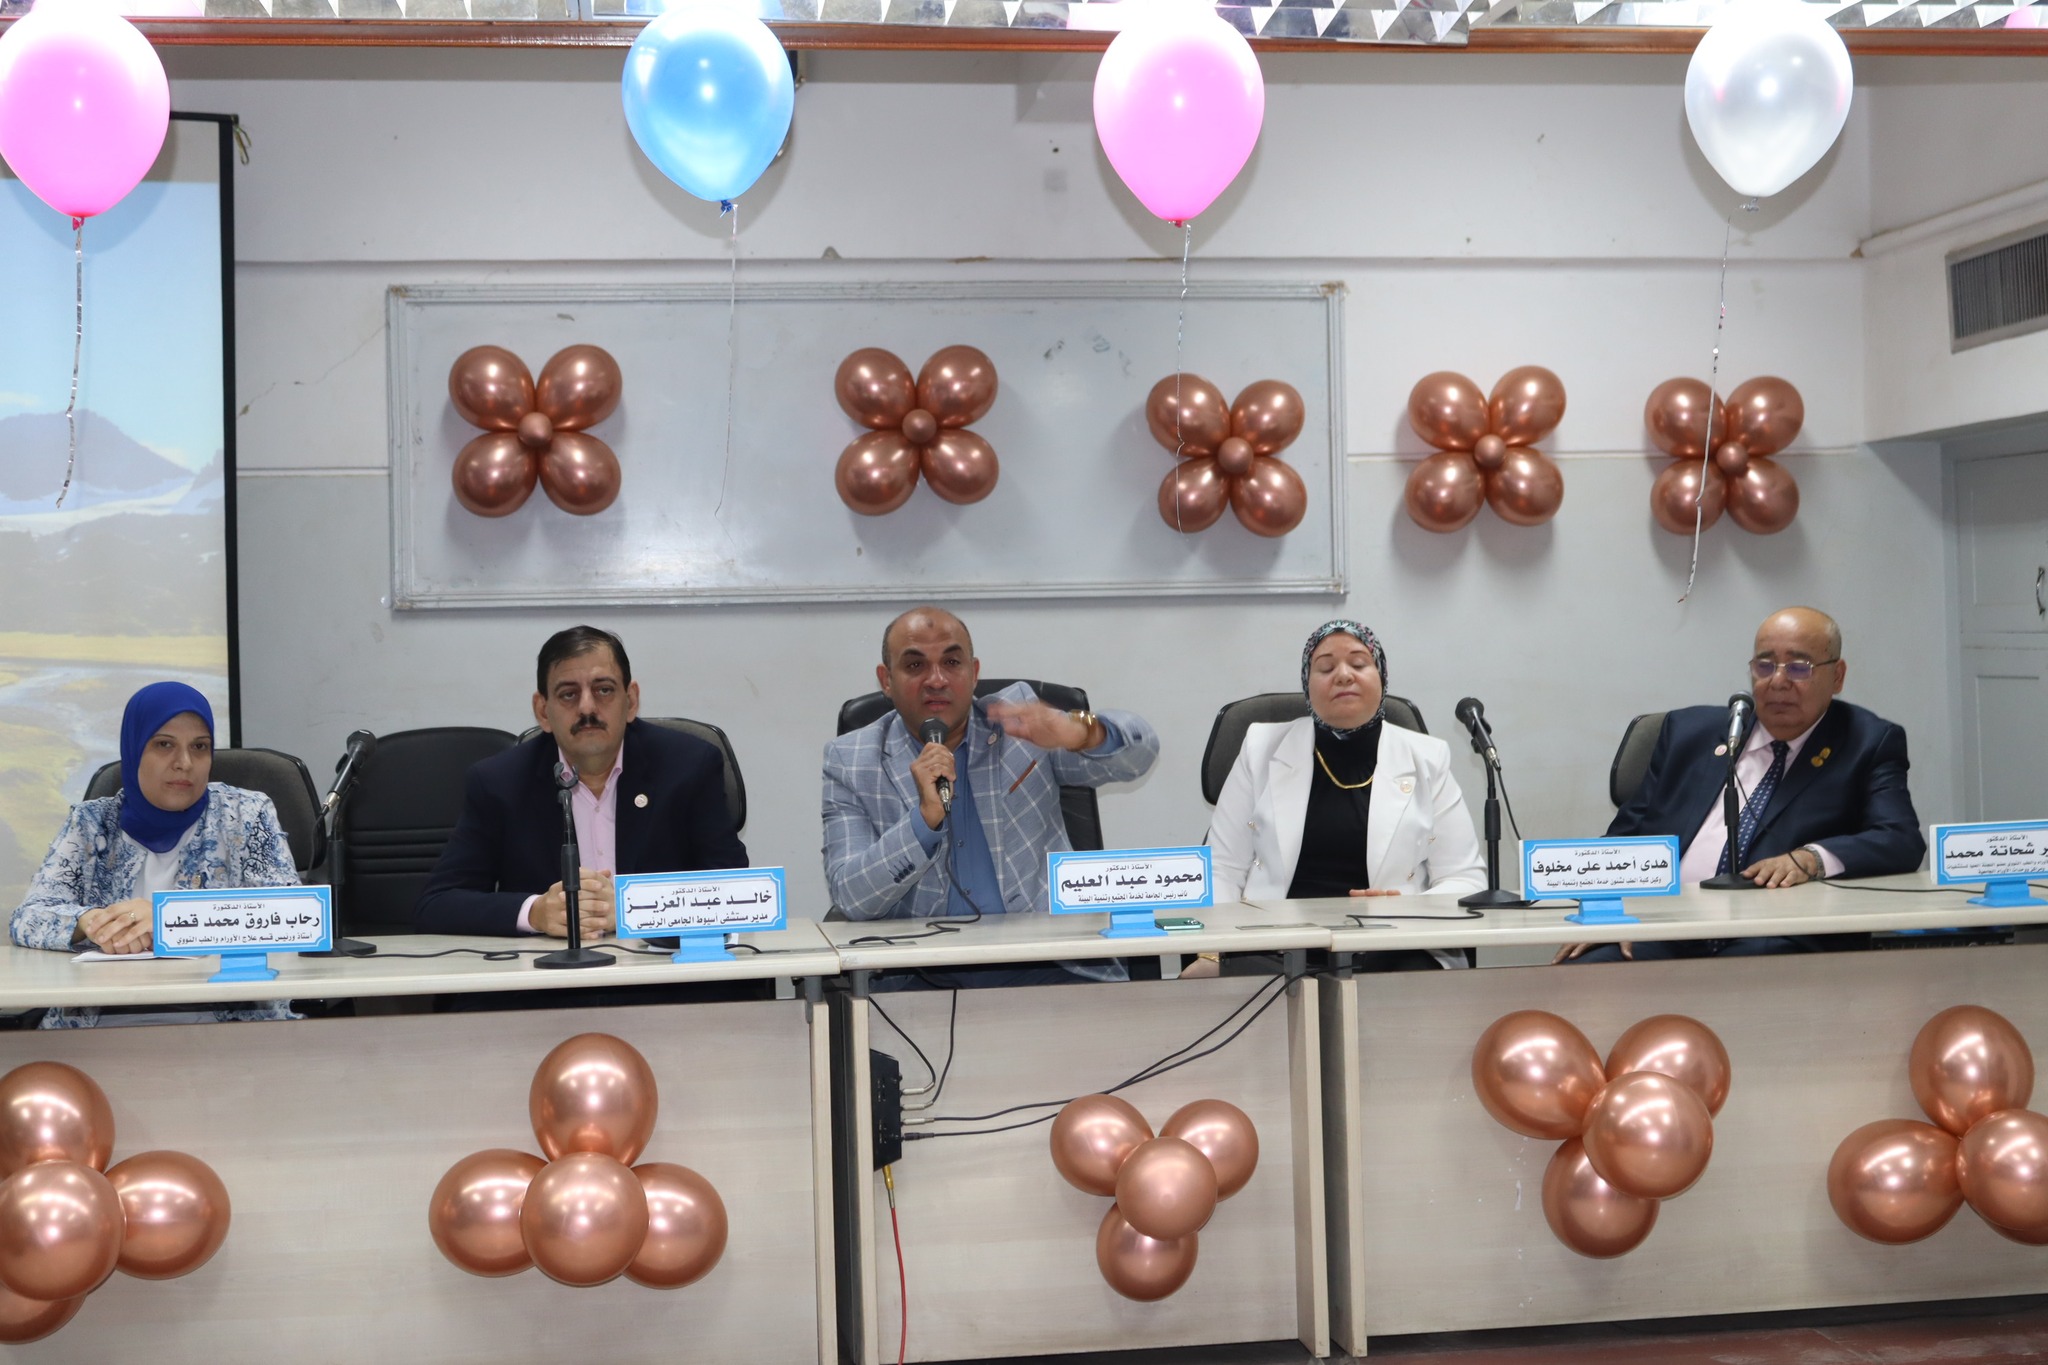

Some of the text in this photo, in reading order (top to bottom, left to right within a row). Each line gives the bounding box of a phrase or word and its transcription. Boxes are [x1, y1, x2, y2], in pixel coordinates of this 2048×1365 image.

[1945, 849, 1984, 859] محمد
[1989, 842, 2035, 856] شحاتة
[1533, 857, 1668, 876] هدى أحمد على مخلوف
[1061, 872, 1202, 892] محمود عبد العليم
[690, 896, 721, 910] عبد
[165, 912, 320, 931] رحاب فاروق محمد قطب
[720, 911, 749, 924] مستشفى
[750, 913, 768, 923] مدير
